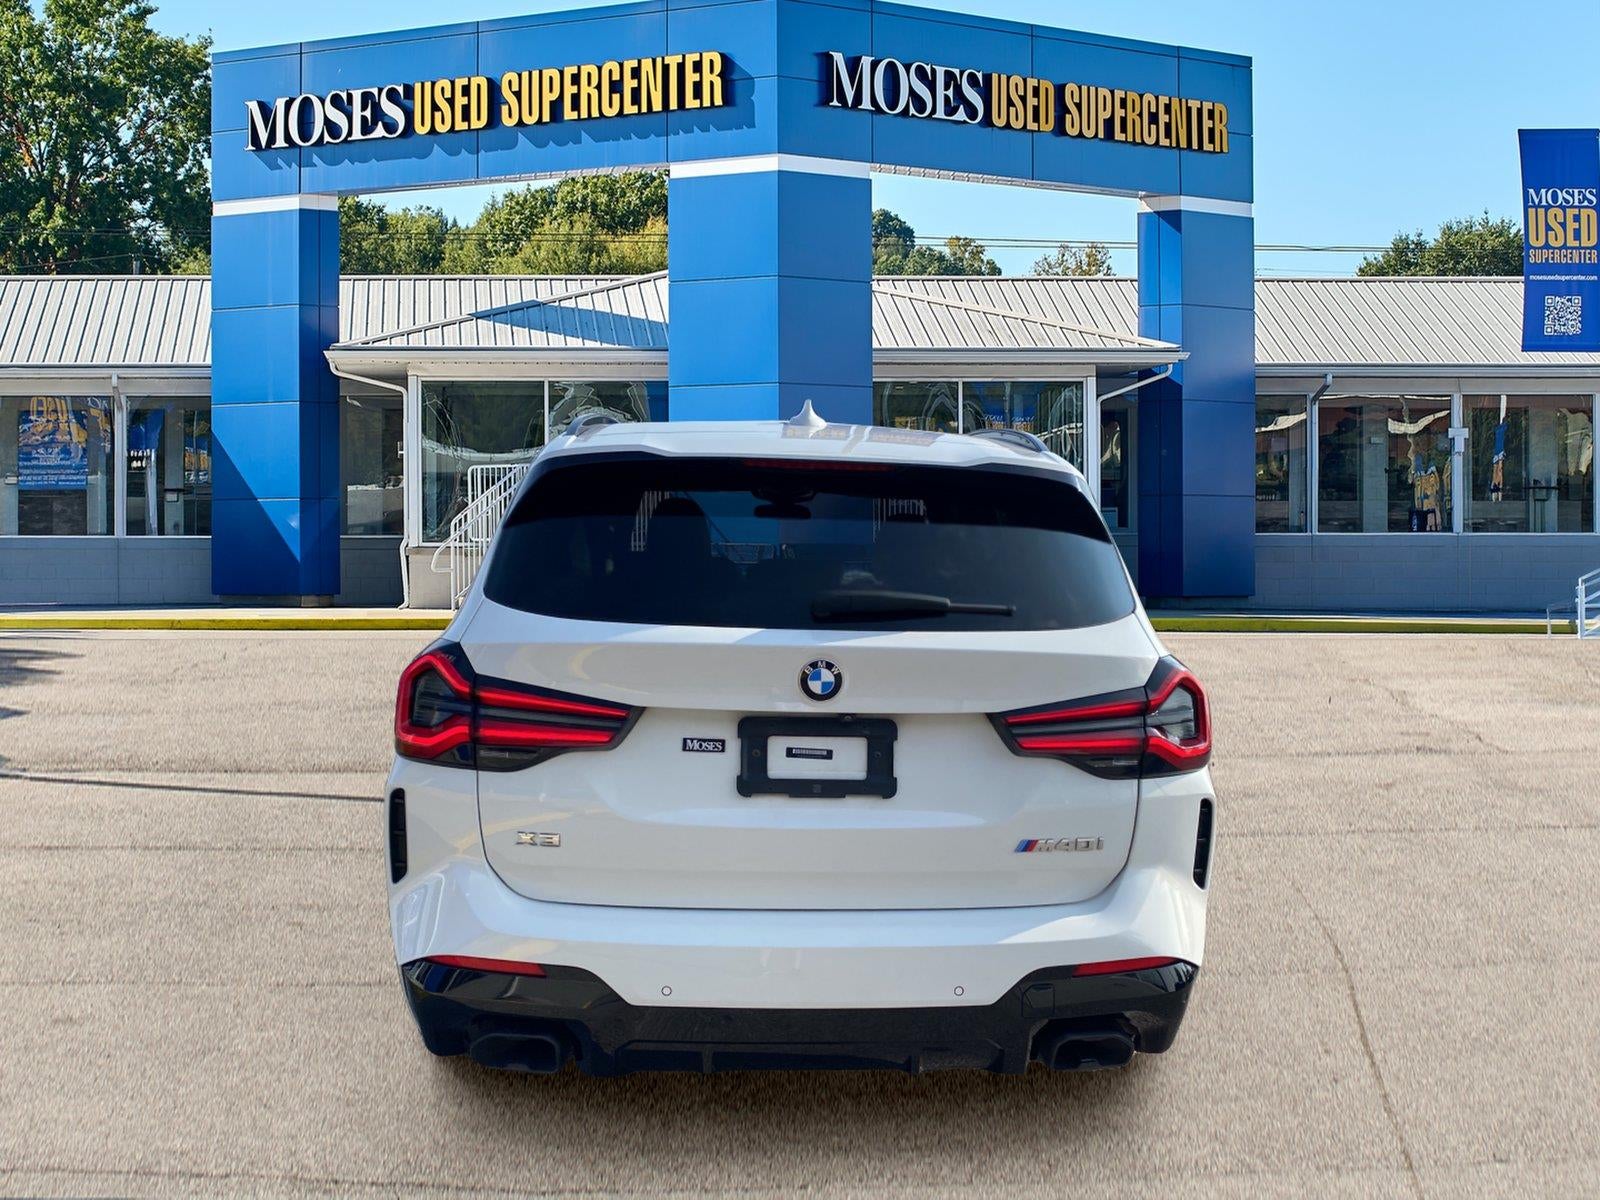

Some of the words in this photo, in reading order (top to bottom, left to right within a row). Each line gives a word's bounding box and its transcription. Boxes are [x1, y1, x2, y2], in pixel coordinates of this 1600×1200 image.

[244, 84, 406, 151] MOSES
[412, 75, 489, 136] USED
[500, 50, 724, 128] SUPERCENTER
[829, 51, 984, 124] MOSES
[991, 73, 1055, 132] USED
[1065, 82, 1229, 153] SUPERCENTER
[1527, 188, 1597, 207] MOSES
[1528, 207, 1598, 247] USED
[1529, 249, 1598, 264] SUPERCENTER
[686, 739, 722, 751] MOSES
[515, 831, 561, 847] X3
